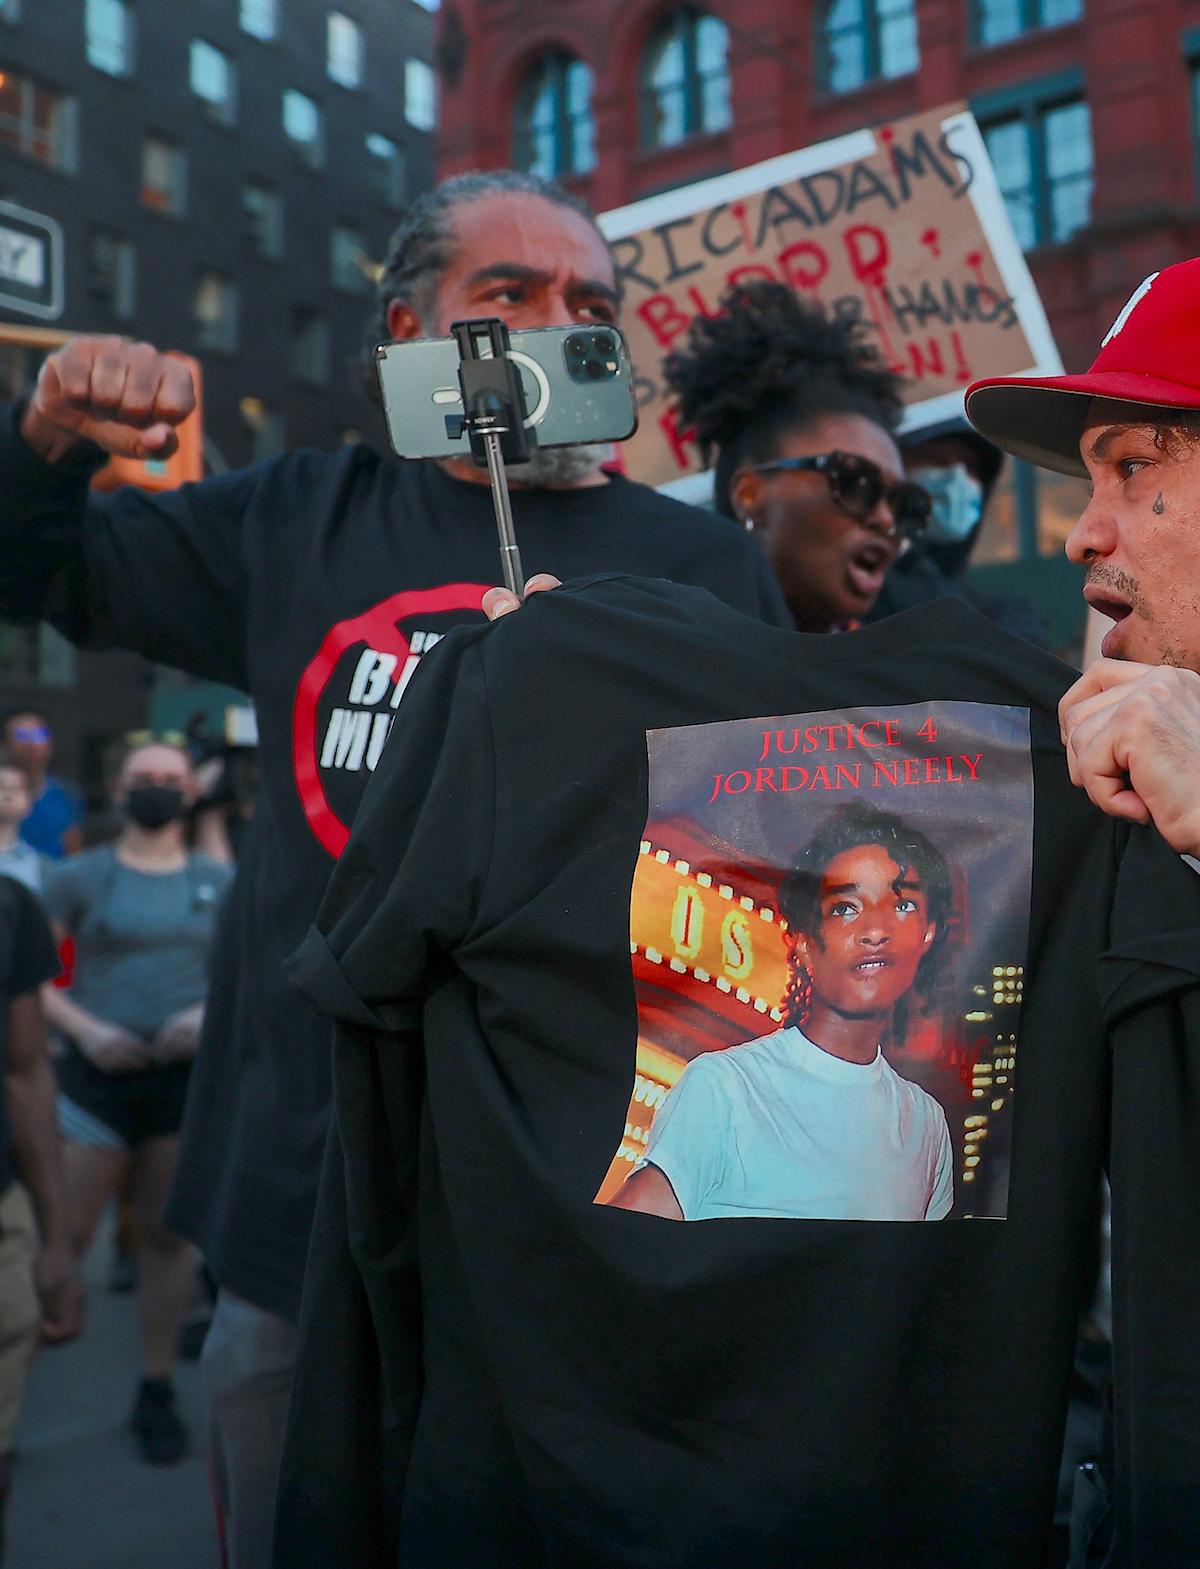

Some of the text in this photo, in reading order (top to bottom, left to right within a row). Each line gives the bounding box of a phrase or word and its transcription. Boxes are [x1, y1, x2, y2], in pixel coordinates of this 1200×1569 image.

[755, 122, 974, 248] ADAMS
[759, 716, 938, 762] JUSTICE 4
[709, 753, 984, 804] JORDAN NEELY
